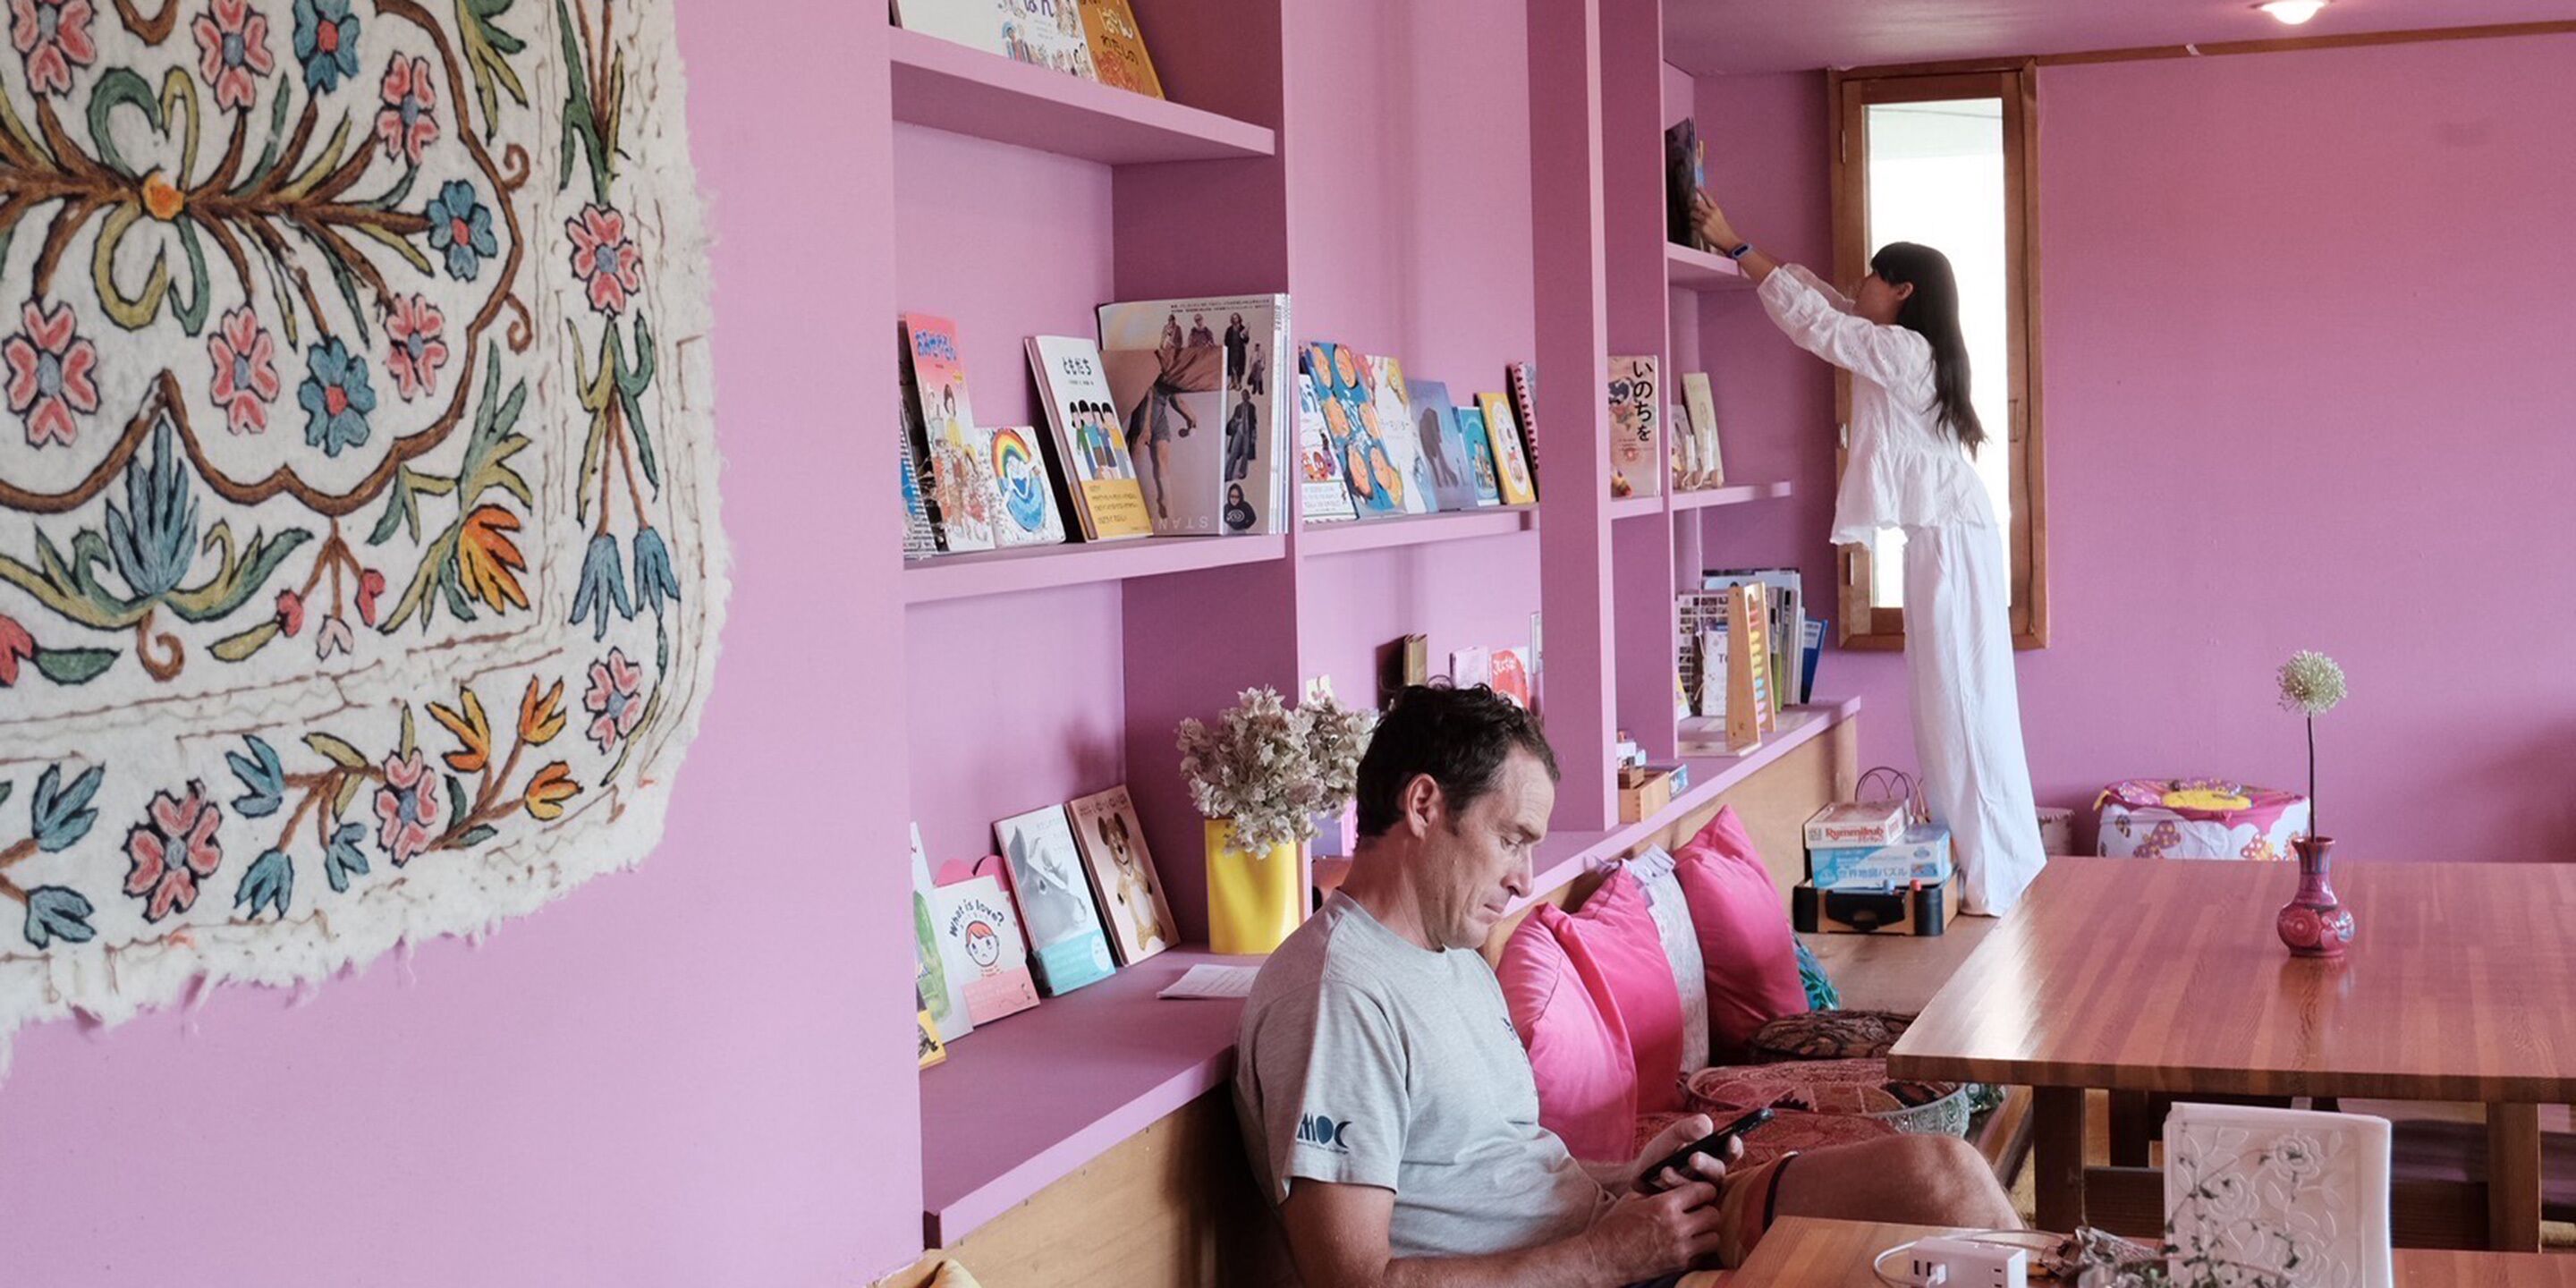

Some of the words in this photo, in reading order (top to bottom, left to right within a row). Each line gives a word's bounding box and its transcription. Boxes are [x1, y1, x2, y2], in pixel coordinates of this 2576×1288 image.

[1633, 360, 1653, 442] いのちを
[949, 905, 965, 937] What
[963, 899, 974, 911] is
[976, 898, 1004, 927] love?
